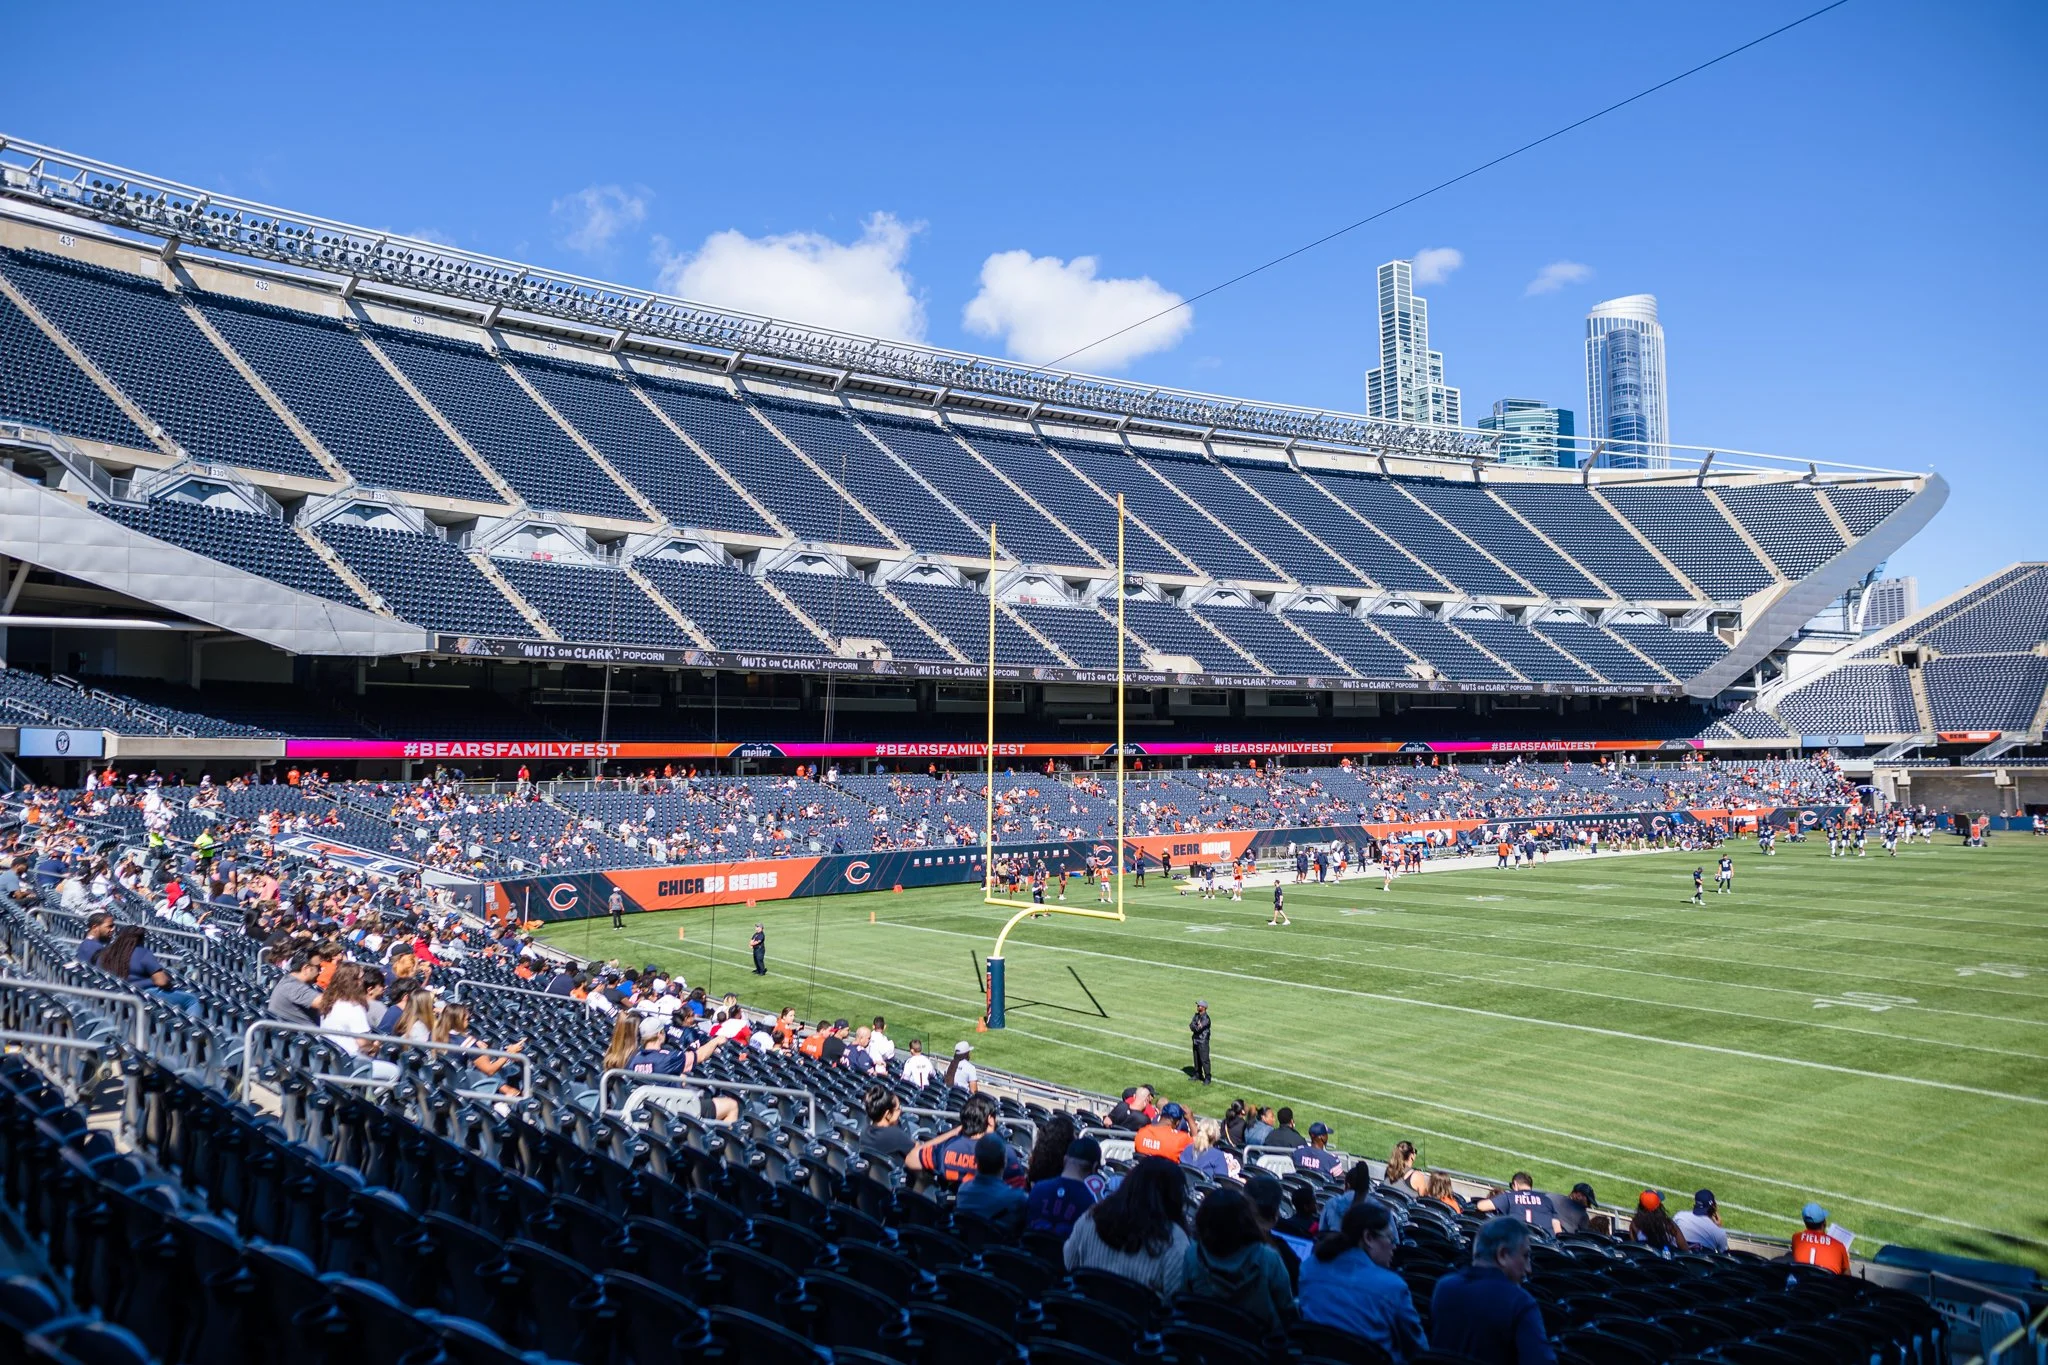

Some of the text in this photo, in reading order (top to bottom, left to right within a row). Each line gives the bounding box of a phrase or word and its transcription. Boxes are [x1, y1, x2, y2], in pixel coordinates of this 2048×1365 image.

[60, 236, 75, 247] 431
[256, 280, 269, 291] 432
[413, 316, 425, 326] 433
[623, 651, 665, 661] POPCORN
[823, 662, 858, 670] POPCORN
[403, 743, 621, 757] #BEARSFAMILYFEST
[1213, 743, 1333, 753] #BEARSFAMILYFEST
[1491, 742, 1597, 751] #BEARSFAMILYFEST
[1173, 843, 1200, 856] BEAR
[729, 871, 778, 892] BEARS
[1142, 1137, 1161, 1150] FIELDS
[1301, 1155, 1320, 1169] FIELDS
[1514, 1194, 1542, 1206] FIELDS
[1800, 1232, 1831, 1246] FIELDS
